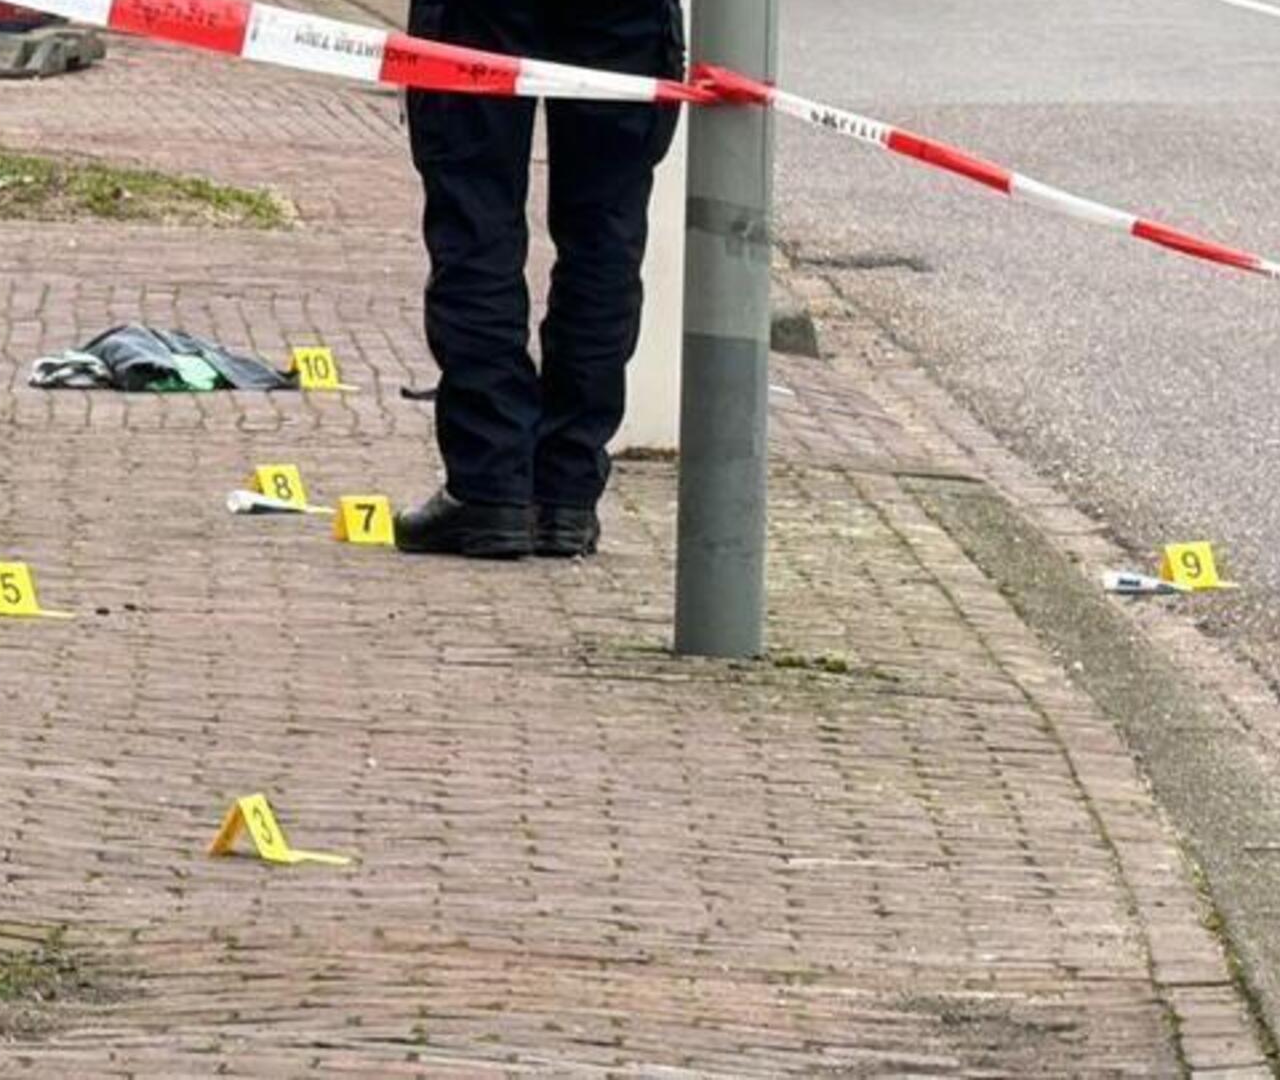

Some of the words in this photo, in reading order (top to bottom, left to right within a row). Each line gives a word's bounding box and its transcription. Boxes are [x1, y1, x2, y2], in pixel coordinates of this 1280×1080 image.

[301, 354, 330, 381] 10
[272, 472, 293, 501] 8
[354, 503, 377, 532] 7
[1180, 550, 1201, 579] 9
[0, 572, 22, 604] 5
